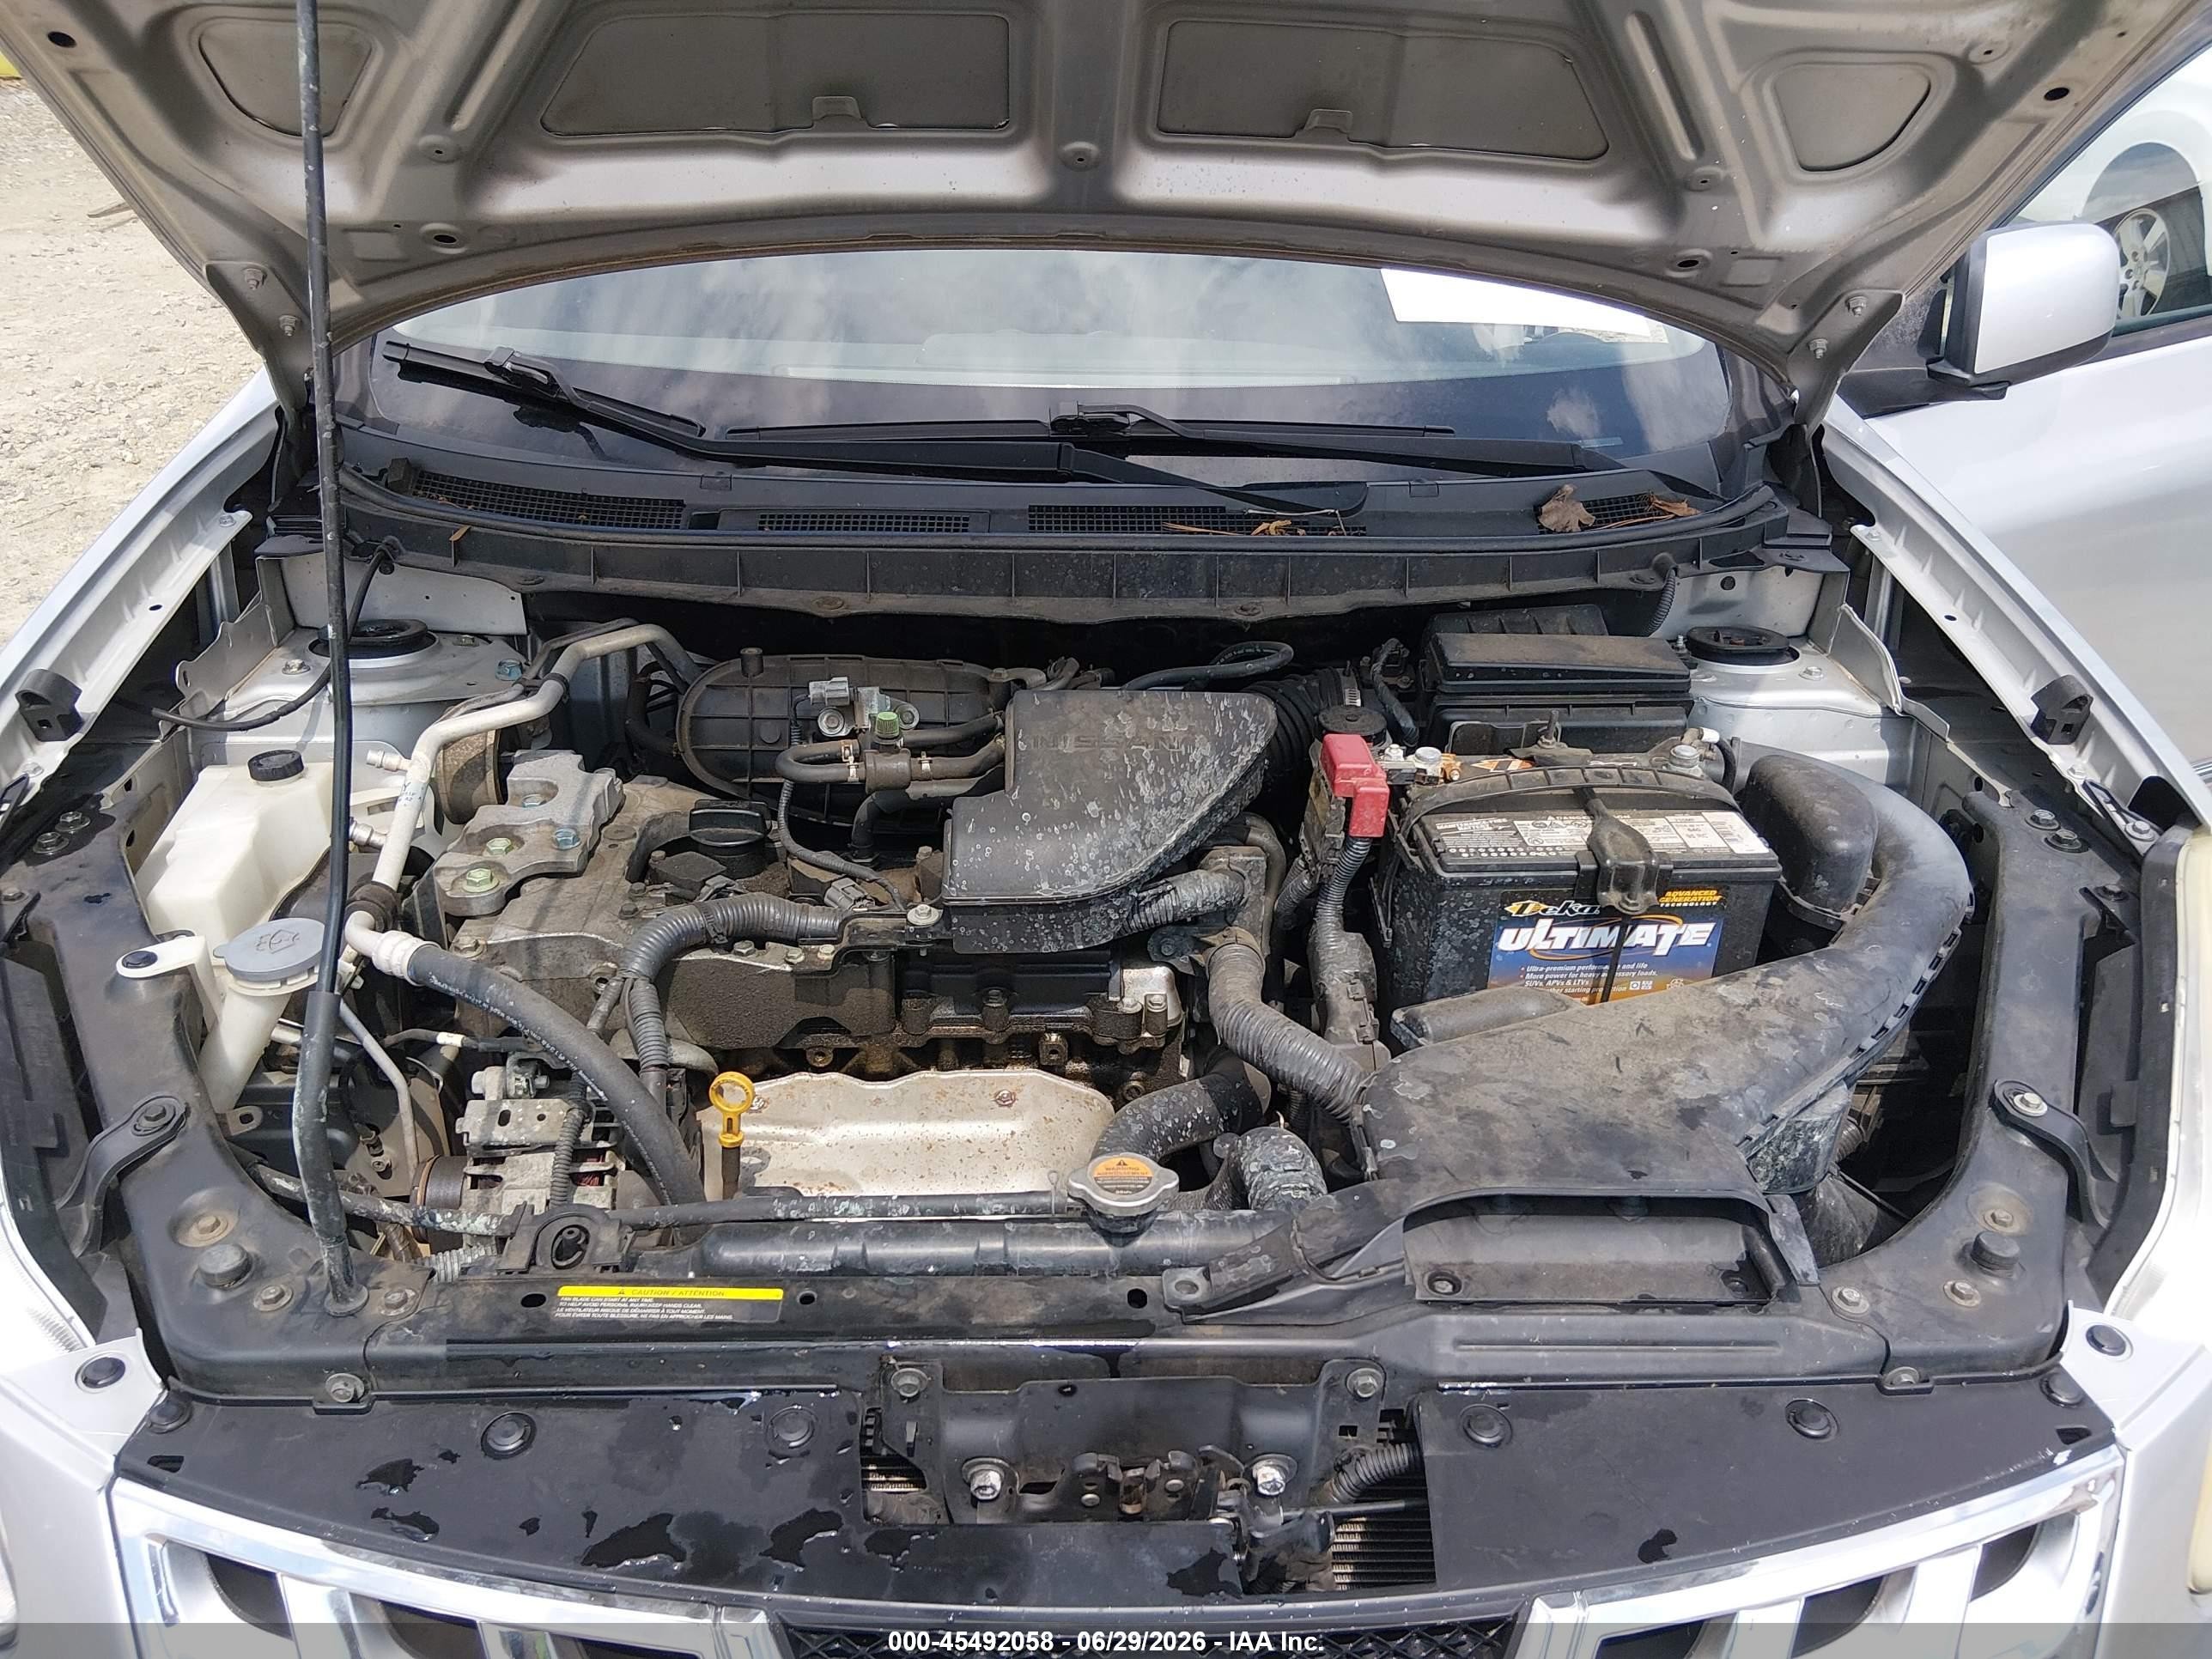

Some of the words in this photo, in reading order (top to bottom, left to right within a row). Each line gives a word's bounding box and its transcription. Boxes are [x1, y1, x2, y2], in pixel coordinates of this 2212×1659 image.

[1504, 900, 1601, 917] Deka
[1498, 918, 1717, 957] ULTIMATE
[1526, 964, 1575, 973] Ultra-premium
